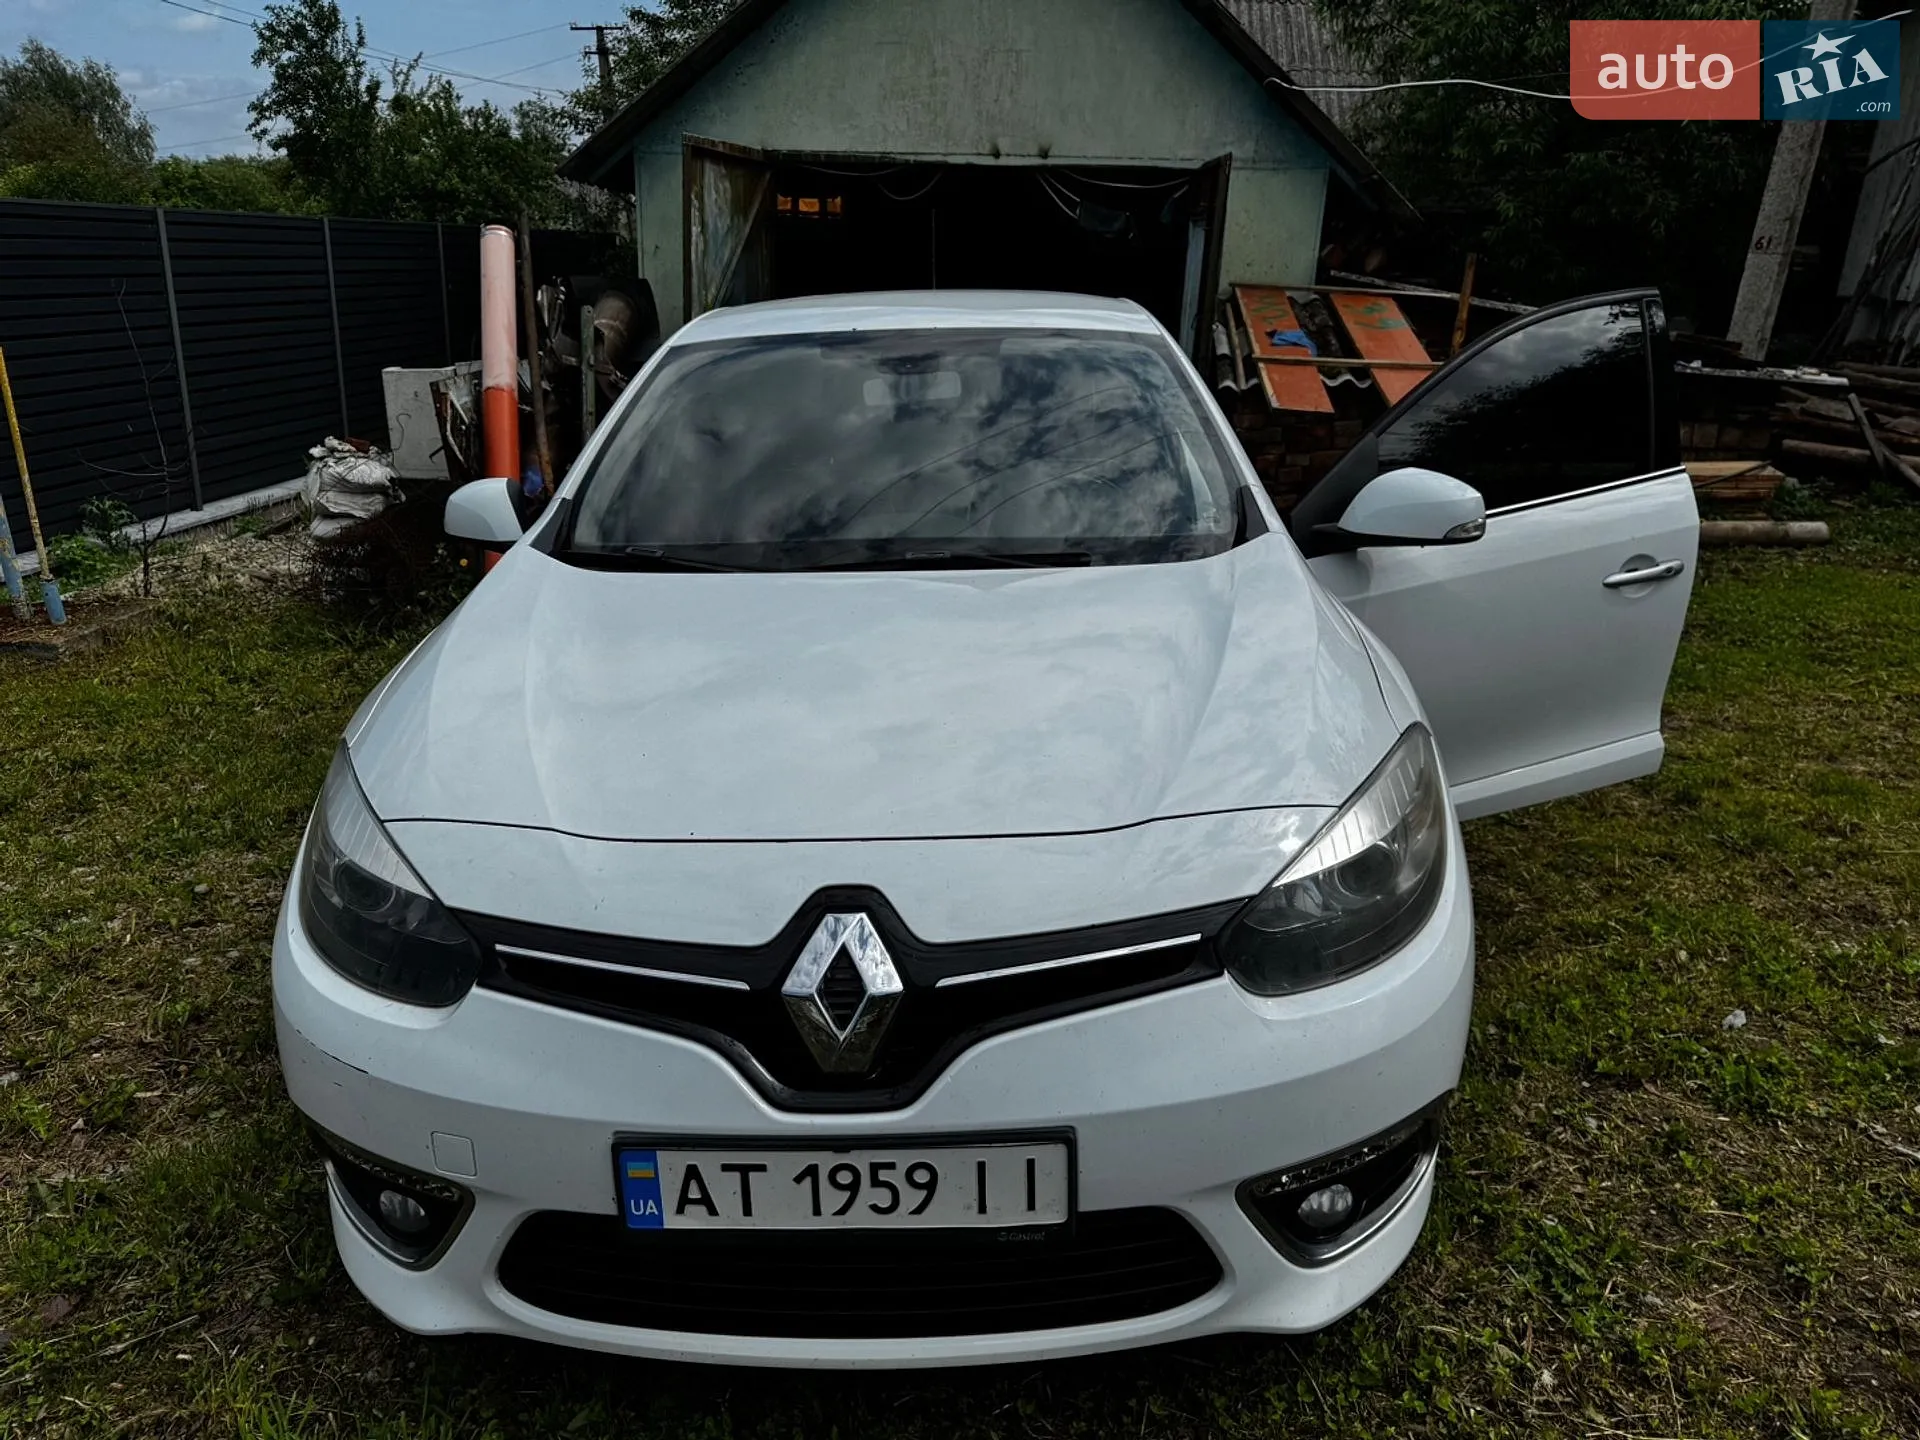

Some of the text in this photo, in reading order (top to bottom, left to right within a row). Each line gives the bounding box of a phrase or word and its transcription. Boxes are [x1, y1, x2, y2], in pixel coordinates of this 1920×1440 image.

[675, 1163, 768, 1217] AT
[792, 1161, 939, 1217] 1959
[631, 1199, 659, 1216] UA
